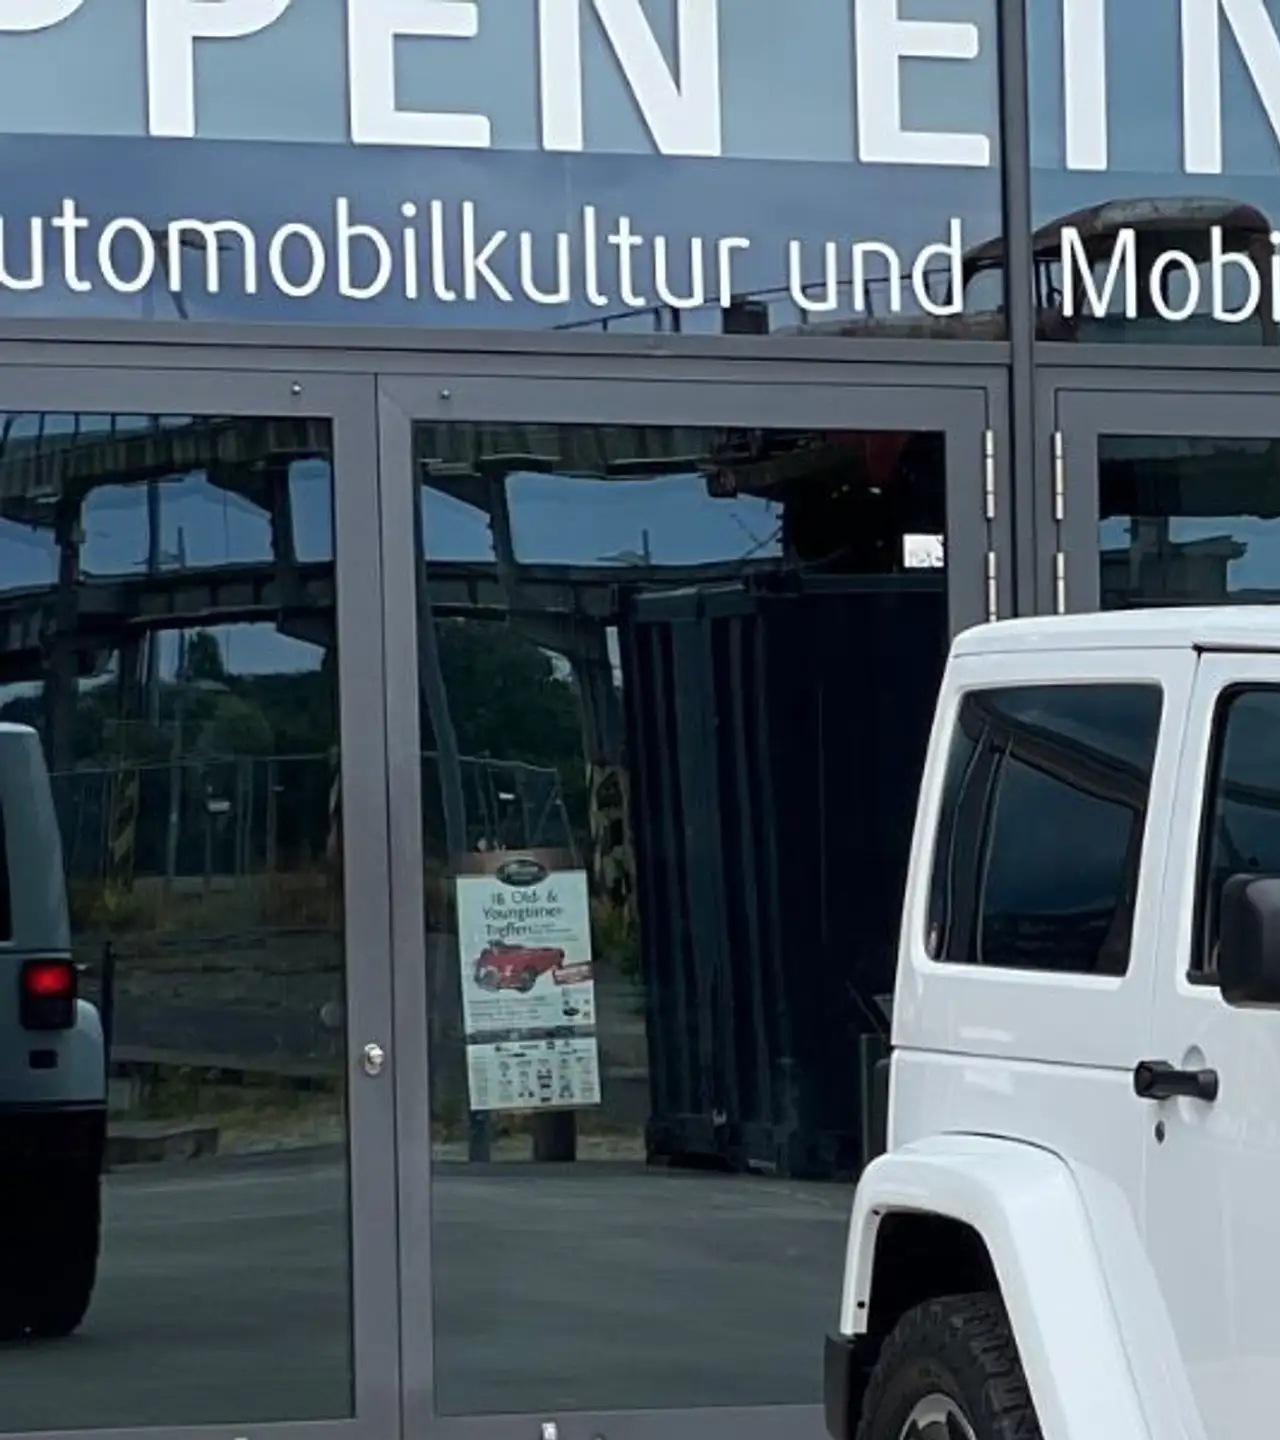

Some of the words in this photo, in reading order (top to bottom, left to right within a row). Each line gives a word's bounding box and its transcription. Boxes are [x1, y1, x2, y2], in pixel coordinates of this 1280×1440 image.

[0, 0, 721, 155] PEN
[0, 198, 750, 309] utomobilkultur
[788, 218, 964, 317] und
